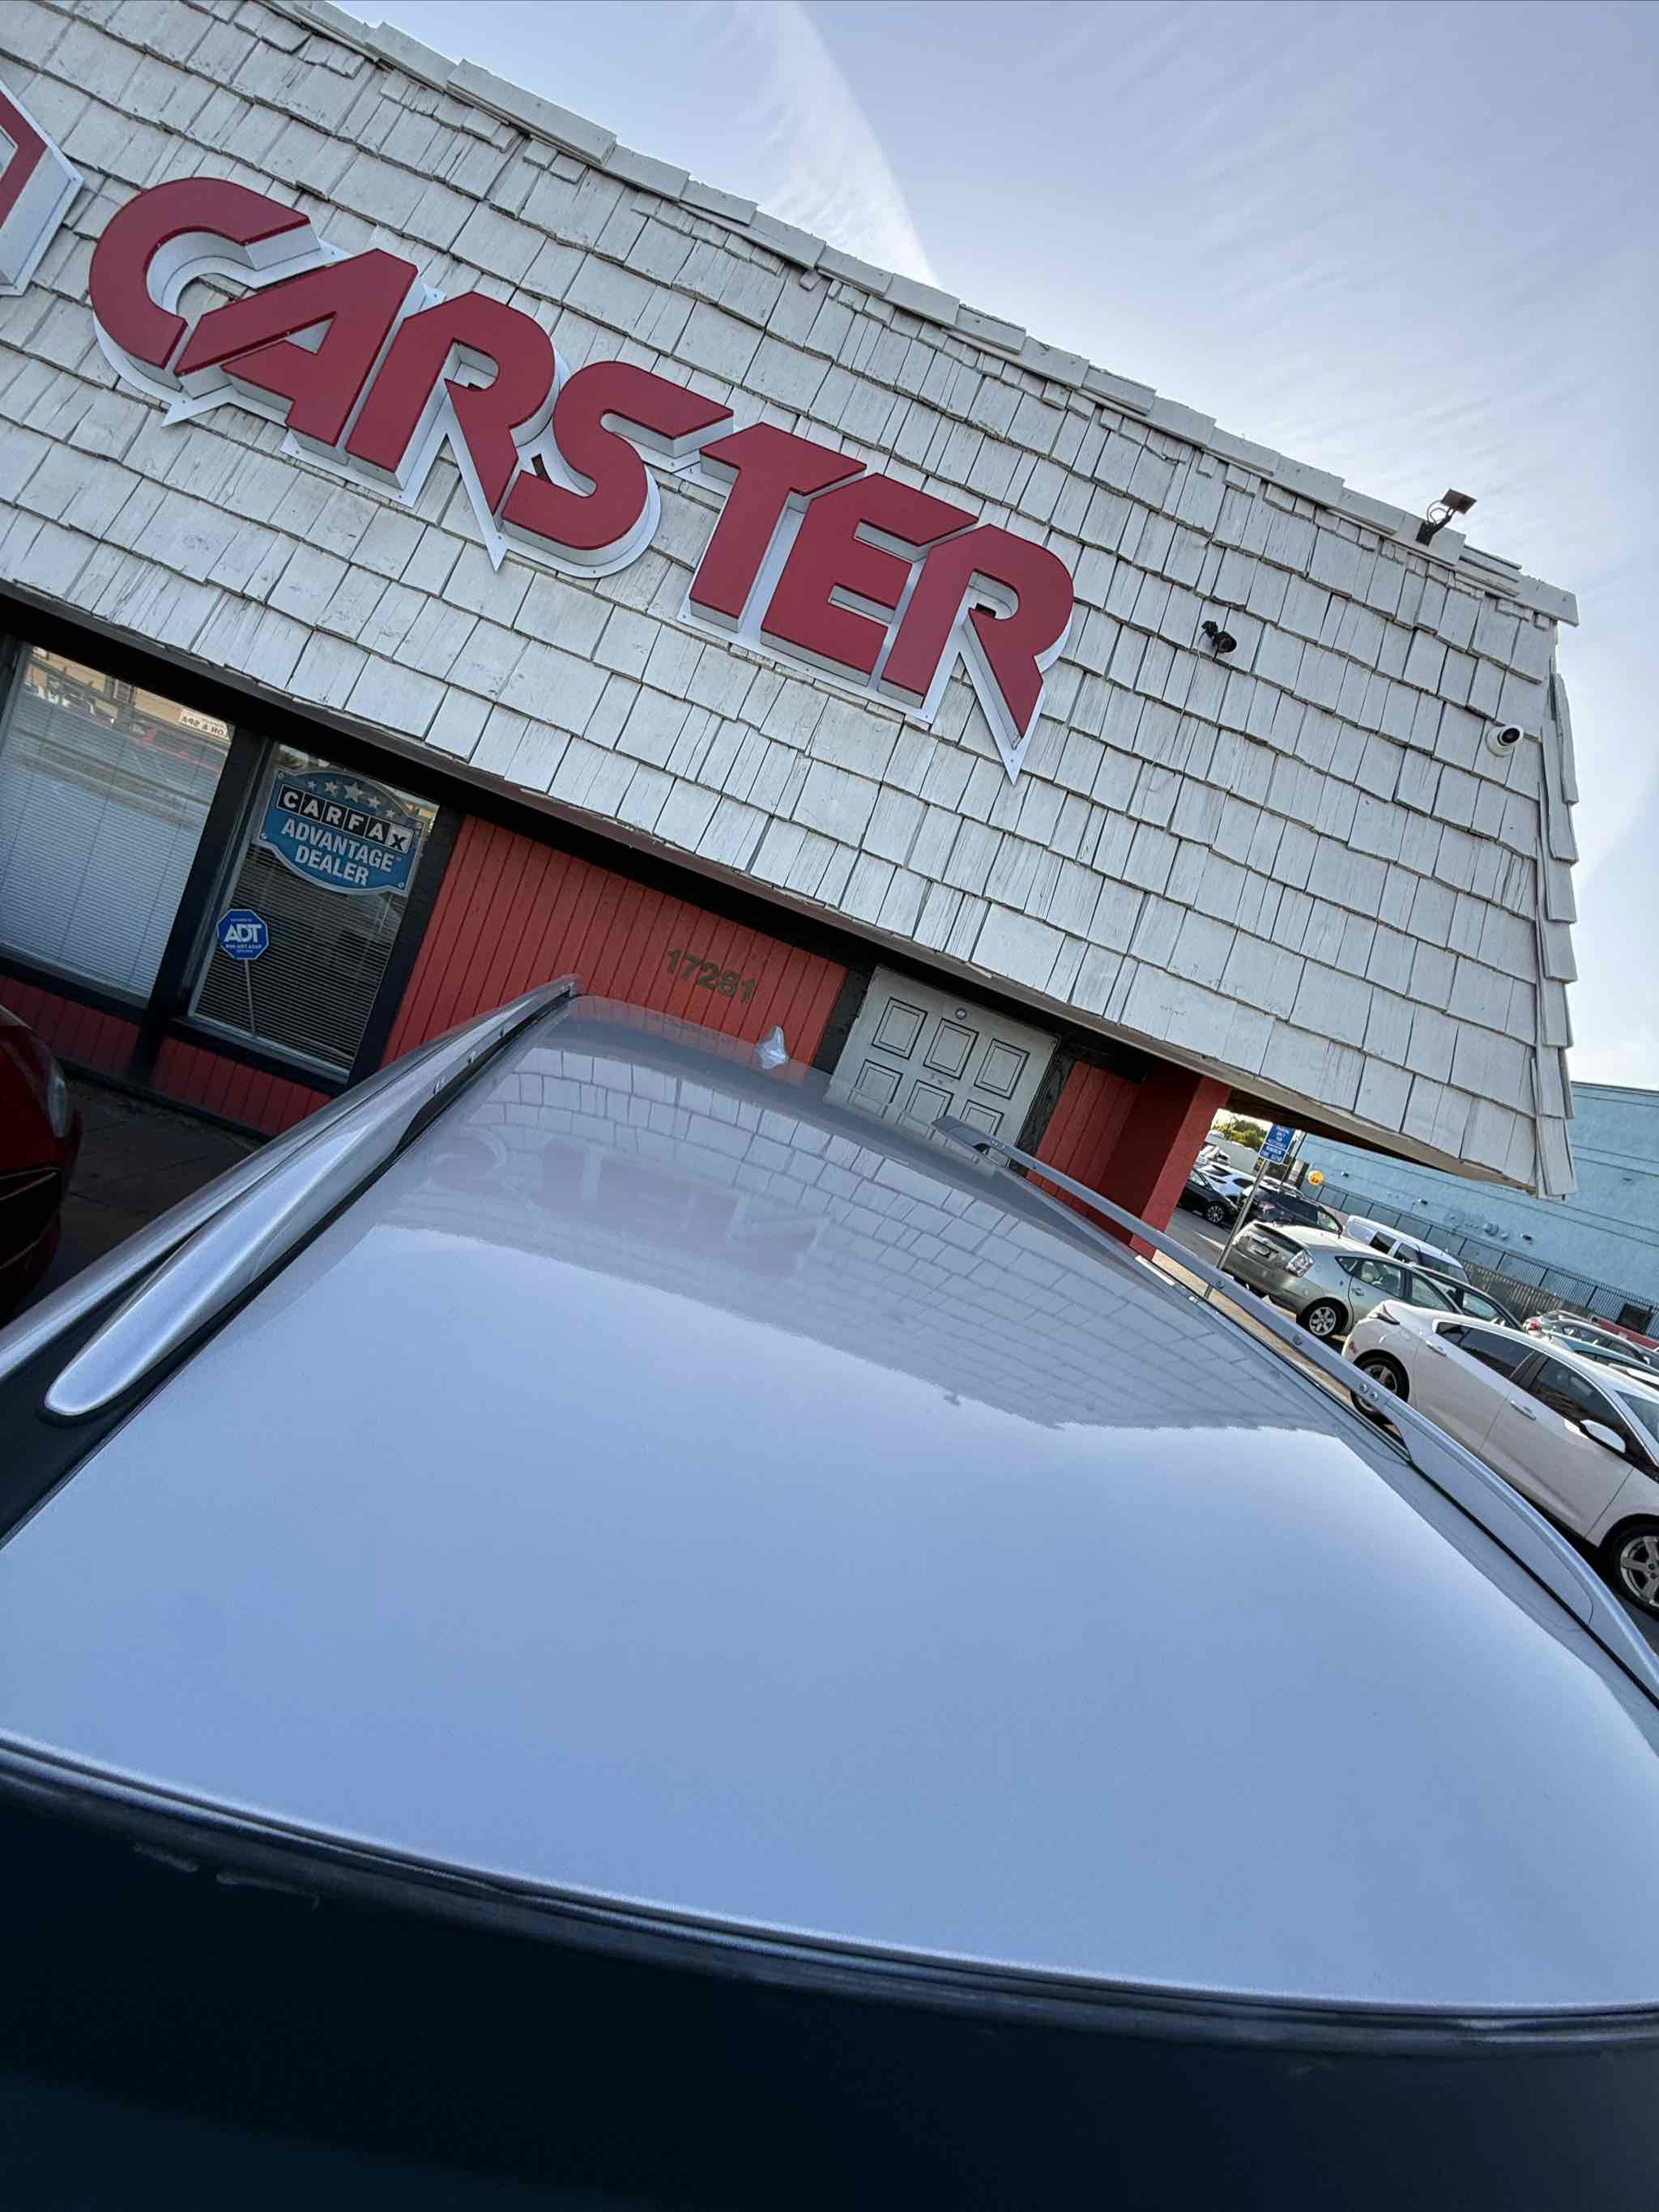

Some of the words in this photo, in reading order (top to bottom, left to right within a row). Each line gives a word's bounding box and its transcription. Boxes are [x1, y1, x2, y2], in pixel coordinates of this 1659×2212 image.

[88, 176, 1076, 743] CARSTER
[281, 818, 394, 872] ADVANTAGE
[283, 791, 407, 851] CARFAX
[295, 845, 369, 885] DEALER
[224, 923, 262, 943] ADT
[667, 948, 756, 1004] 17281
